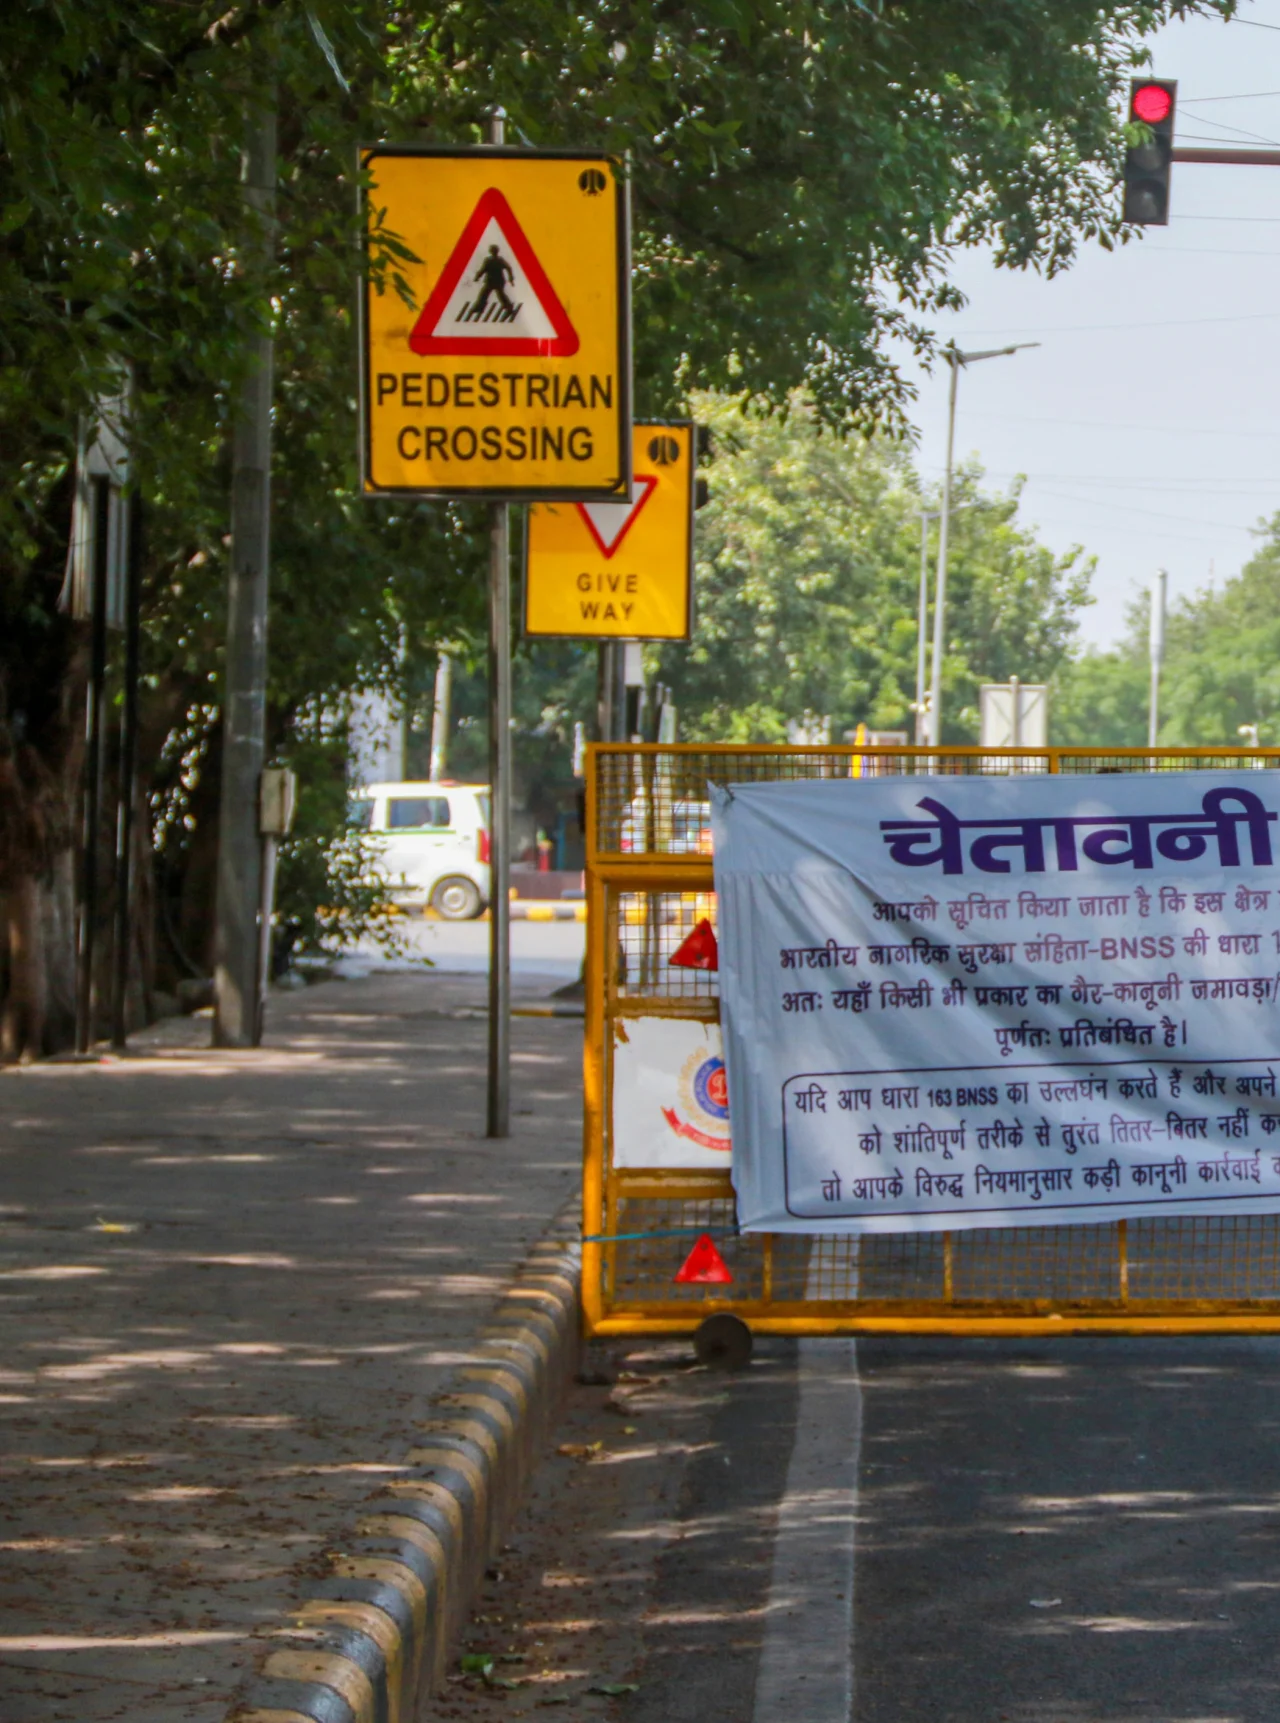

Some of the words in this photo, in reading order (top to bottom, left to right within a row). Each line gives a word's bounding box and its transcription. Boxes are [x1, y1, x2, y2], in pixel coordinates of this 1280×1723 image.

[377, 373, 613, 409] PEDESTRIAN
[397, 426, 594, 461] CROSSING
[577, 573, 639, 593] GIVE
[581, 602, 634, 621] WAY
[880, 787, 1277, 875] चेतावनी
[873, 895, 938, 922] आपको
[948, 893, 1010, 930] सूचित
[1018, 891, 1070, 918] किया
[1078, 895, 1130, 917] जाता
[1134, 886, 1151, 918] है
[1159, 886, 1186, 914] कि
[1194, 892, 1226, 914] इस
[1235, 884, 1271, 913] क्षेत्र
[780, 939, 859, 969] भारतीय
[867, 937, 950, 966] नागरिक
[957, 943, 1016, 973] सुरक्षा
[1182, 928, 1210, 956] की
[1218, 934, 1262, 954] धारा
[832, 981, 871, 1013] यहाँ
[879, 980, 934, 1009] किसी
[942, 978, 967, 1006] भी
[974, 986, 1028, 1006] प्रकार
[1035, 985, 1063, 1004] का
[1058, 1018, 1155, 1048] प्रतिबंधित
[794, 1082, 826, 1113] यदि
[837, 1089, 871, 1111] आप
[882, 1087, 919, 1110] धारा
[927, 1090, 952, 1108] 163
[957, 1087, 998, 1107] BNSS
[1006, 1082, 1028, 1104] का
[1118, 1068, 1157, 1099] करते
[1169, 1068, 1184, 1099] हैं
[1193, 1069, 1226, 1096] और
[1235, 1067, 1276, 1096] अपने
[858, 1124, 881, 1155] को
[894, 1120, 965, 1159] शांतिपूर्ण
[977, 1118, 1022, 1149] तरीके
[1035, 1116, 1050, 1147] से
[1061, 1117, 1099, 1154] तुरंत
[1218, 1108, 1248, 1138] नहीं
[821, 1170, 841, 1201] तो
[852, 1168, 903, 1200] आपके
[915, 1167, 964, 1198] विरुद्ध
[975, 1165, 1072, 1200] नियमानुसार
[1083, 1158, 1120, 1193] कड़ी
[1131, 1155, 1187, 1193] कानूनी
[1197, 1149, 1261, 1183] कार्रवाई
